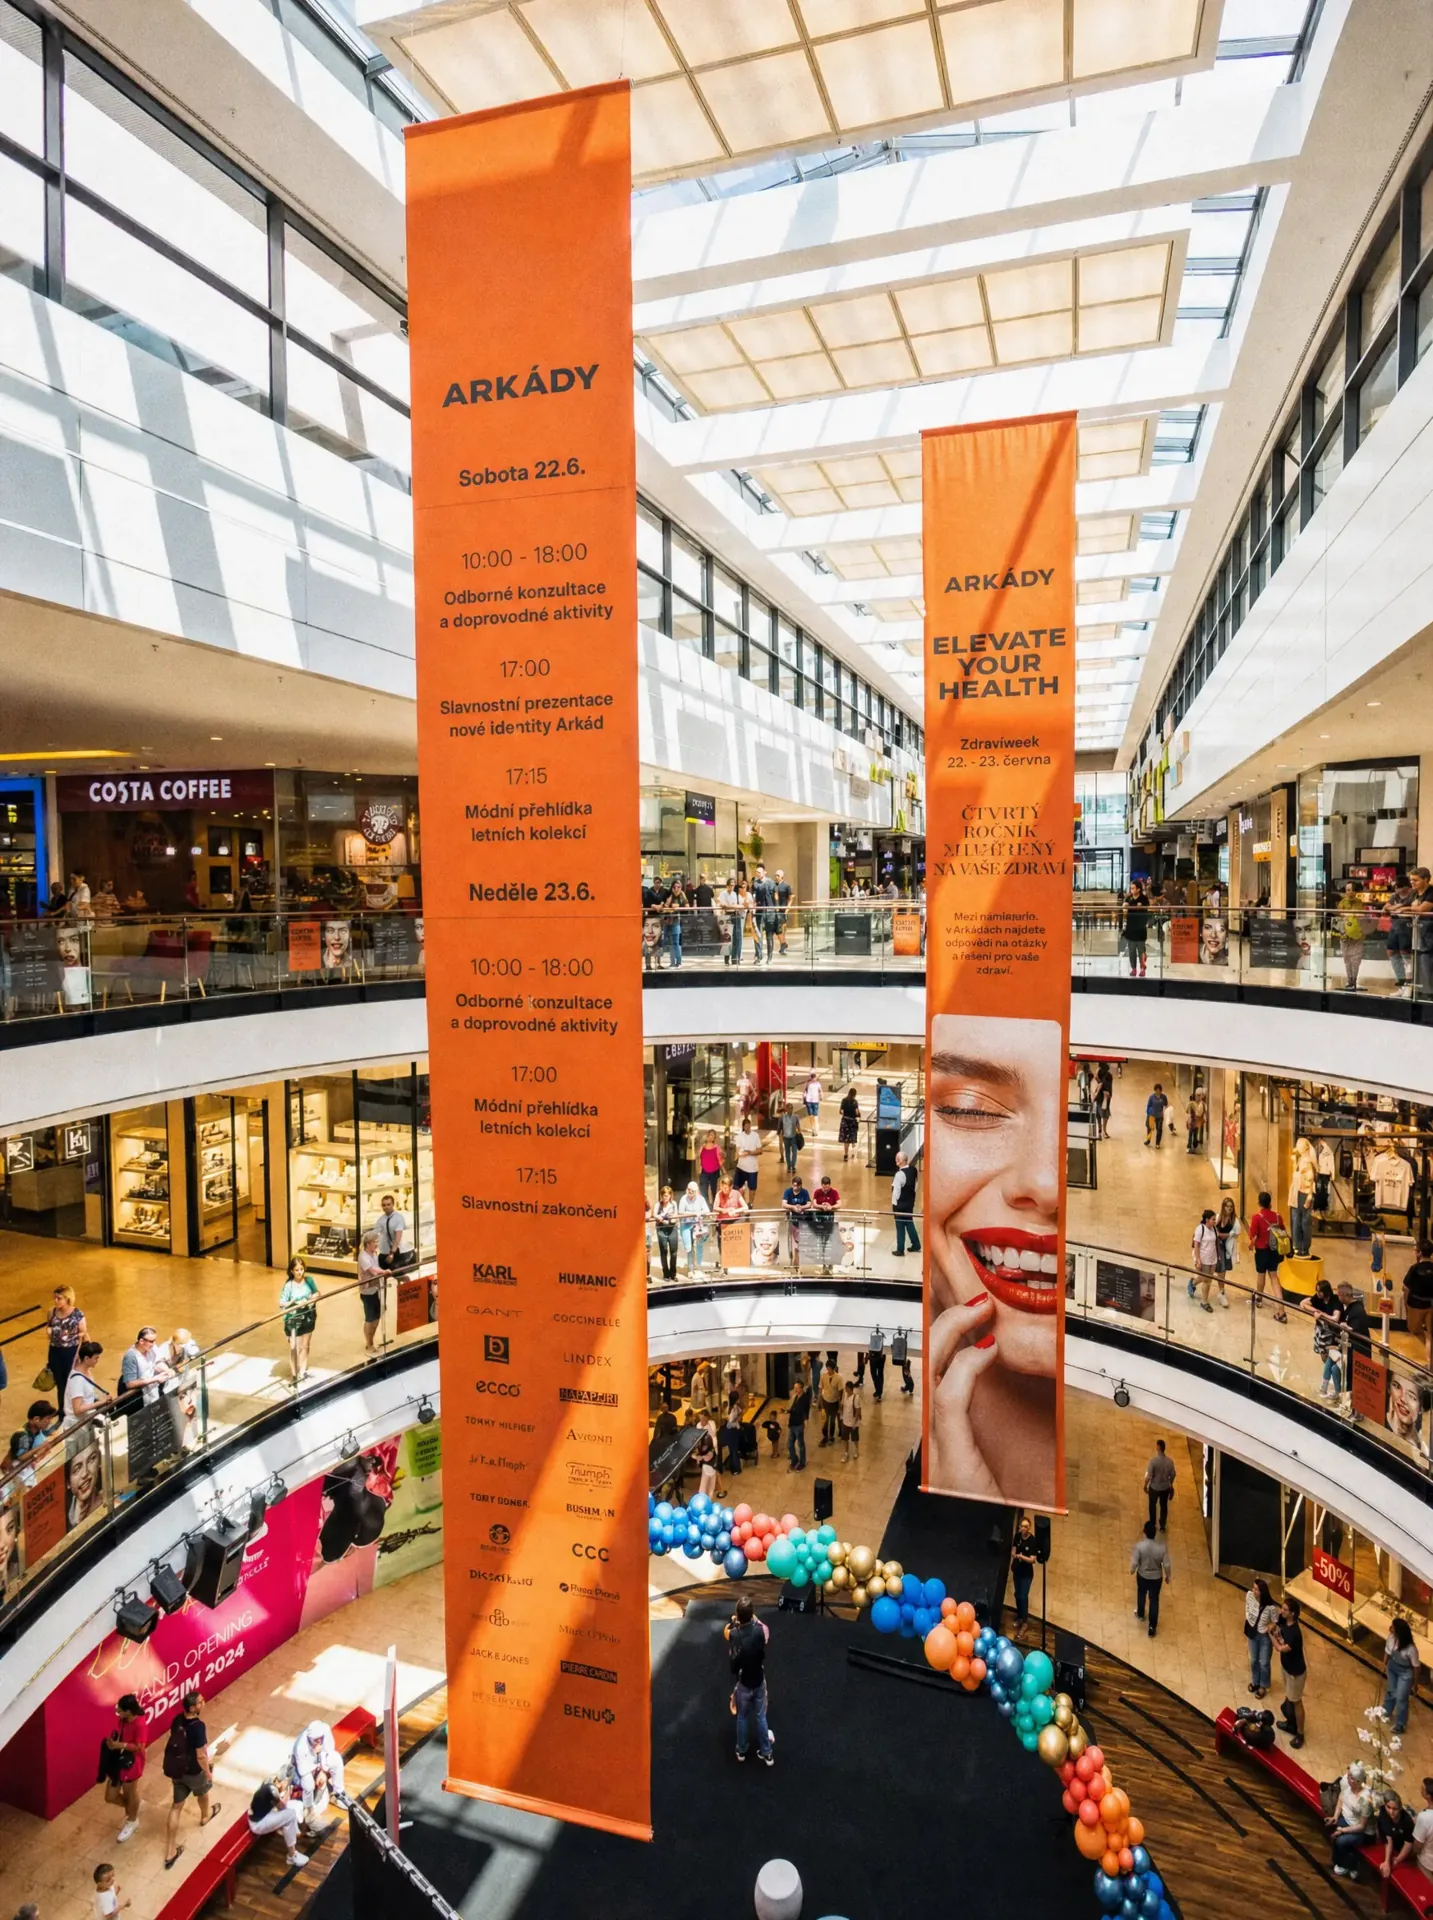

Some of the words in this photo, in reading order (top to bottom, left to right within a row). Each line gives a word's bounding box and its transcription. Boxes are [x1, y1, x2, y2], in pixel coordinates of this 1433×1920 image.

[442, 364, 600, 408] ARKÁDY
[459, 466, 529, 487] Sobota
[534, 457, 586, 479] 22.6.
[461, 549, 513, 570] 10:00
[534, 542, 588, 564] 18:00
[944, 568, 1055, 593] ARKÁDY
[444, 586, 513, 606] Odborné
[517, 581, 606, 600] konzultace
[439, 617, 449, 629] a
[453, 607, 549, 629] doprovodné
[553, 604, 614, 622] aktivity
[933, 627, 1066, 655] ELEVATE
[500, 658, 551, 678] 17:00
[957, 653, 1041, 677] YOUR
[939, 676, 1059, 700] HEALTH
[440, 696, 521, 715] Slavnostní
[525, 694, 614, 713] prezentace
[450, 721, 486, 737] nové
[490, 718, 552, 736] identity
[555, 715, 604, 731] Arkád
[947, 756, 967, 769] 22.
[980, 755, 1000, 767] 23.
[1003, 753, 1051, 767] června
[506, 767, 548, 785] 17:15
[89, 781, 154, 804] COSTA
[160, 779, 231, 800] COFFEE
[465, 803, 514, 820] Módní
[518, 801, 593, 821] přehlídka
[961, 803, 1042, 821] ČTVRTÝ
[471, 825, 525, 842] letních
[530, 824, 586, 841] kolekcí
[964, 822, 1039, 839] ROČNÍK
[933, 862, 956, 876] NA
[960, 859, 1001, 876] VAŠE
[1003, 859, 1067, 876] ZDRAVÍ
[469, 882, 538, 902] Neděle
[544, 881, 596, 901] 23.6.
[953, 925, 1002, 935] Arkádách
[1004, 925, 1046, 936] najdete
[995, 940, 1009, 948] na
[1011, 938, 1048, 949] otázky
[952, 953, 958, 961] a
[993, 953, 1013, 963] pro
[1015, 952, 1040, 961] vaše
[470, 958, 522, 977] 10:00
[541, 958, 594, 977] 18:00
[455, 993, 524, 1009] Odborné
[528, 994, 613, 1010] konzultace
[451, 1018, 459, 1029] a
[464, 1016, 556, 1034] doprovodné
[560, 1018, 619, 1036] aktivity
[511, 1065, 557, 1083] 17:00
[474, 1098, 522, 1114] Módní
[527, 1100, 598, 1117] přehlídka
[480, 1120, 532, 1136] letních
[536, 1122, 591, 1138] kolekcí
[516, 1167, 557, 1185] 17:15
[461, 1195, 538, 1214] Slavnostní
[541, 1204, 618, 1219] zakončení
[472, 1263, 517, 1281] KARL
[558, 1272, 617, 1288] HUMANIC
[466, 1305, 524, 1318] GANT
[553, 1313, 621, 1328] COCCINELLE
[563, 1352, 612, 1367] LINDEX
[571, 1542, 610, 1563] CCC
[1314, 1556, 1351, 1593] -50%
[183, 1609, 253, 1669] OPENING
[204, 1640, 245, 1683] 2024
[470, 1647, 493, 1660] JACK
[502, 1653, 530, 1666] JONES
[563, 1703, 601, 1722] BENU
